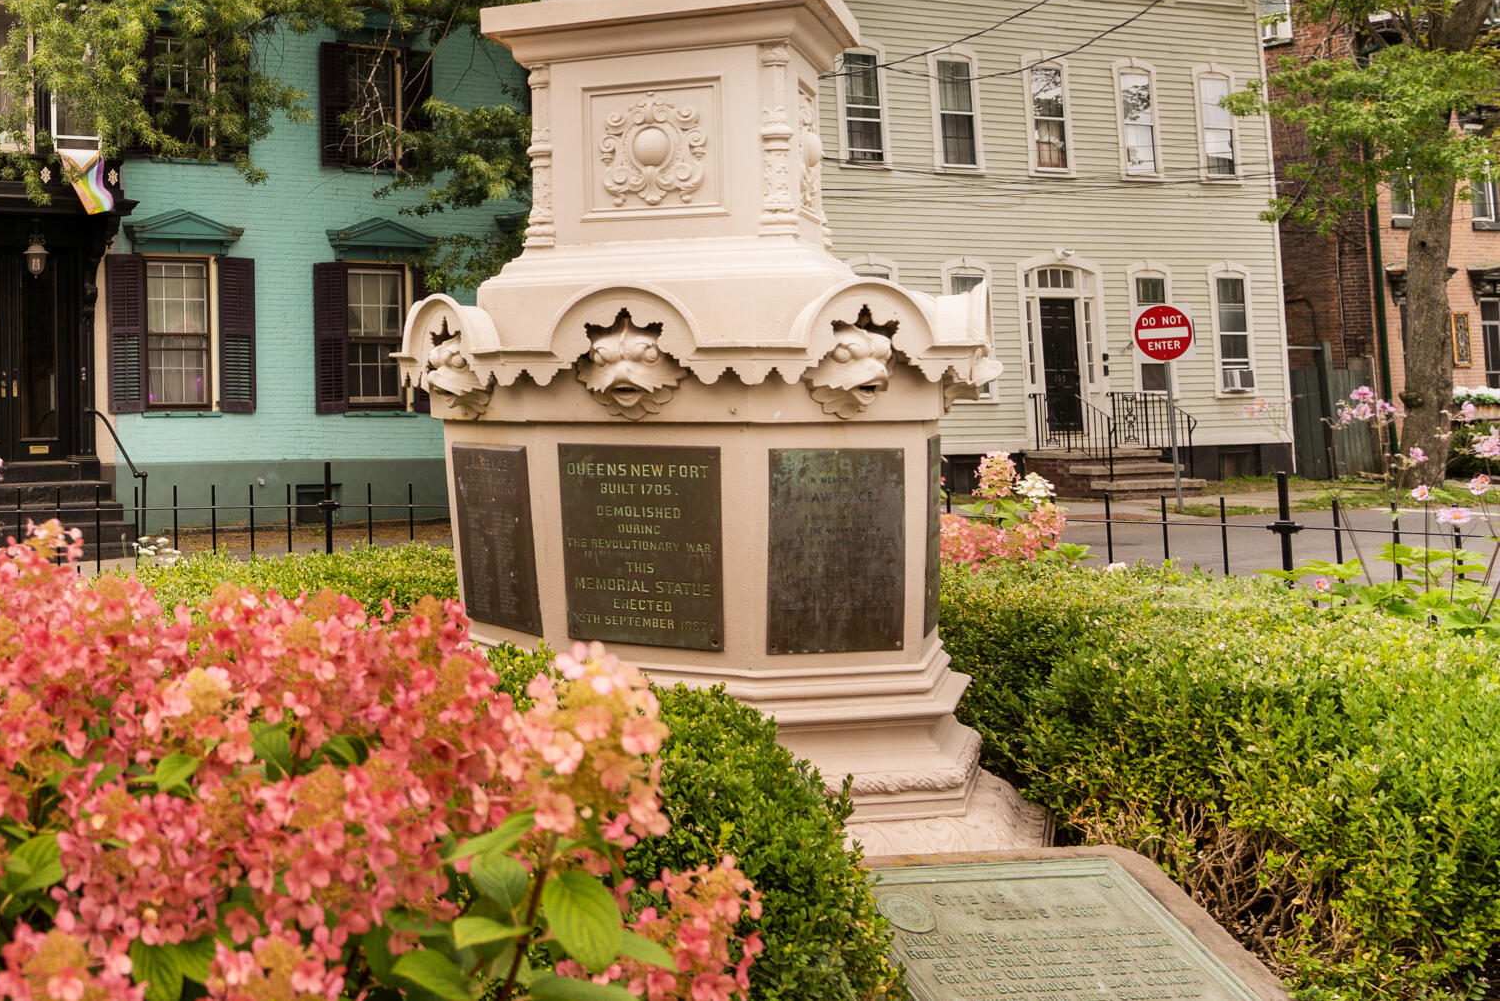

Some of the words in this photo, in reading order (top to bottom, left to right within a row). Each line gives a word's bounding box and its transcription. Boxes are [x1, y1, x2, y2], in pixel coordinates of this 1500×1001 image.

[1141, 317, 1156, 327] DO
[1162, 315, 1182, 325] NOT
[1148, 340, 1181, 351] ENTER
[567, 463, 627, 476] QUEENS
[630, 463, 663, 477] NEW
[669, 465, 709, 479] FORT
[600, 483, 636, 494] BUILT
[641, 483, 679, 496] 1705.
[596, 505, 681, 519] DEMOLISHED
[617, 523, 661, 535] DURING
[566, 537, 587, 547] THE
[591, 538, 679, 552] REVOLUTIONARY
[625, 561, 655, 573] THIS
[574, 576, 649, 592] MEMORIAL
[655, 581, 712, 596] STATUE
[613, 598, 672, 612] ERECTED
[604, 615, 675, 630] SEPTEMBER
[932, 893, 980, 905] SITE
[901, 935, 942, 947] BUILT
[905, 947, 960, 959] REBUILT
[933, 960, 960, 971] SET
[933, 972, 970, 984] FORT
